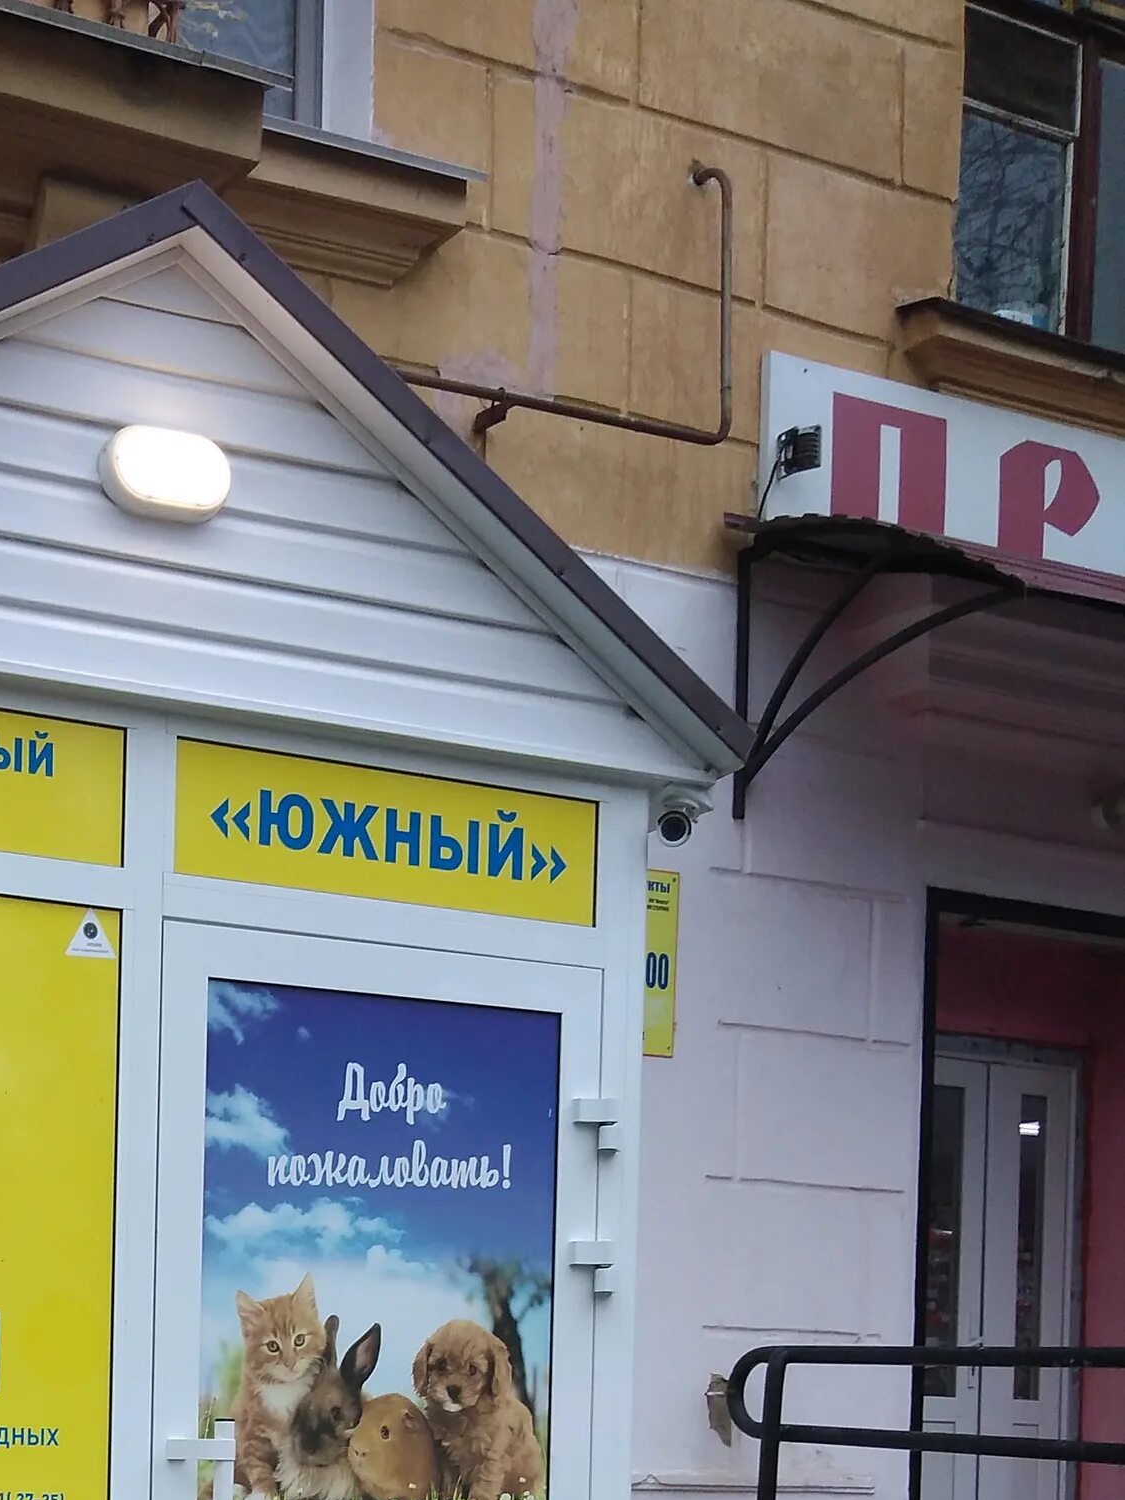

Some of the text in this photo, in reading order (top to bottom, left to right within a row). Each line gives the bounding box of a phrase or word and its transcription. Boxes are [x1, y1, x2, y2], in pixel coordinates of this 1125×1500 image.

[830, 391, 1100, 560] ПР
[336, 1061, 447, 1125] Добро
[267, 1139, 512, 1190] пожаловать!
